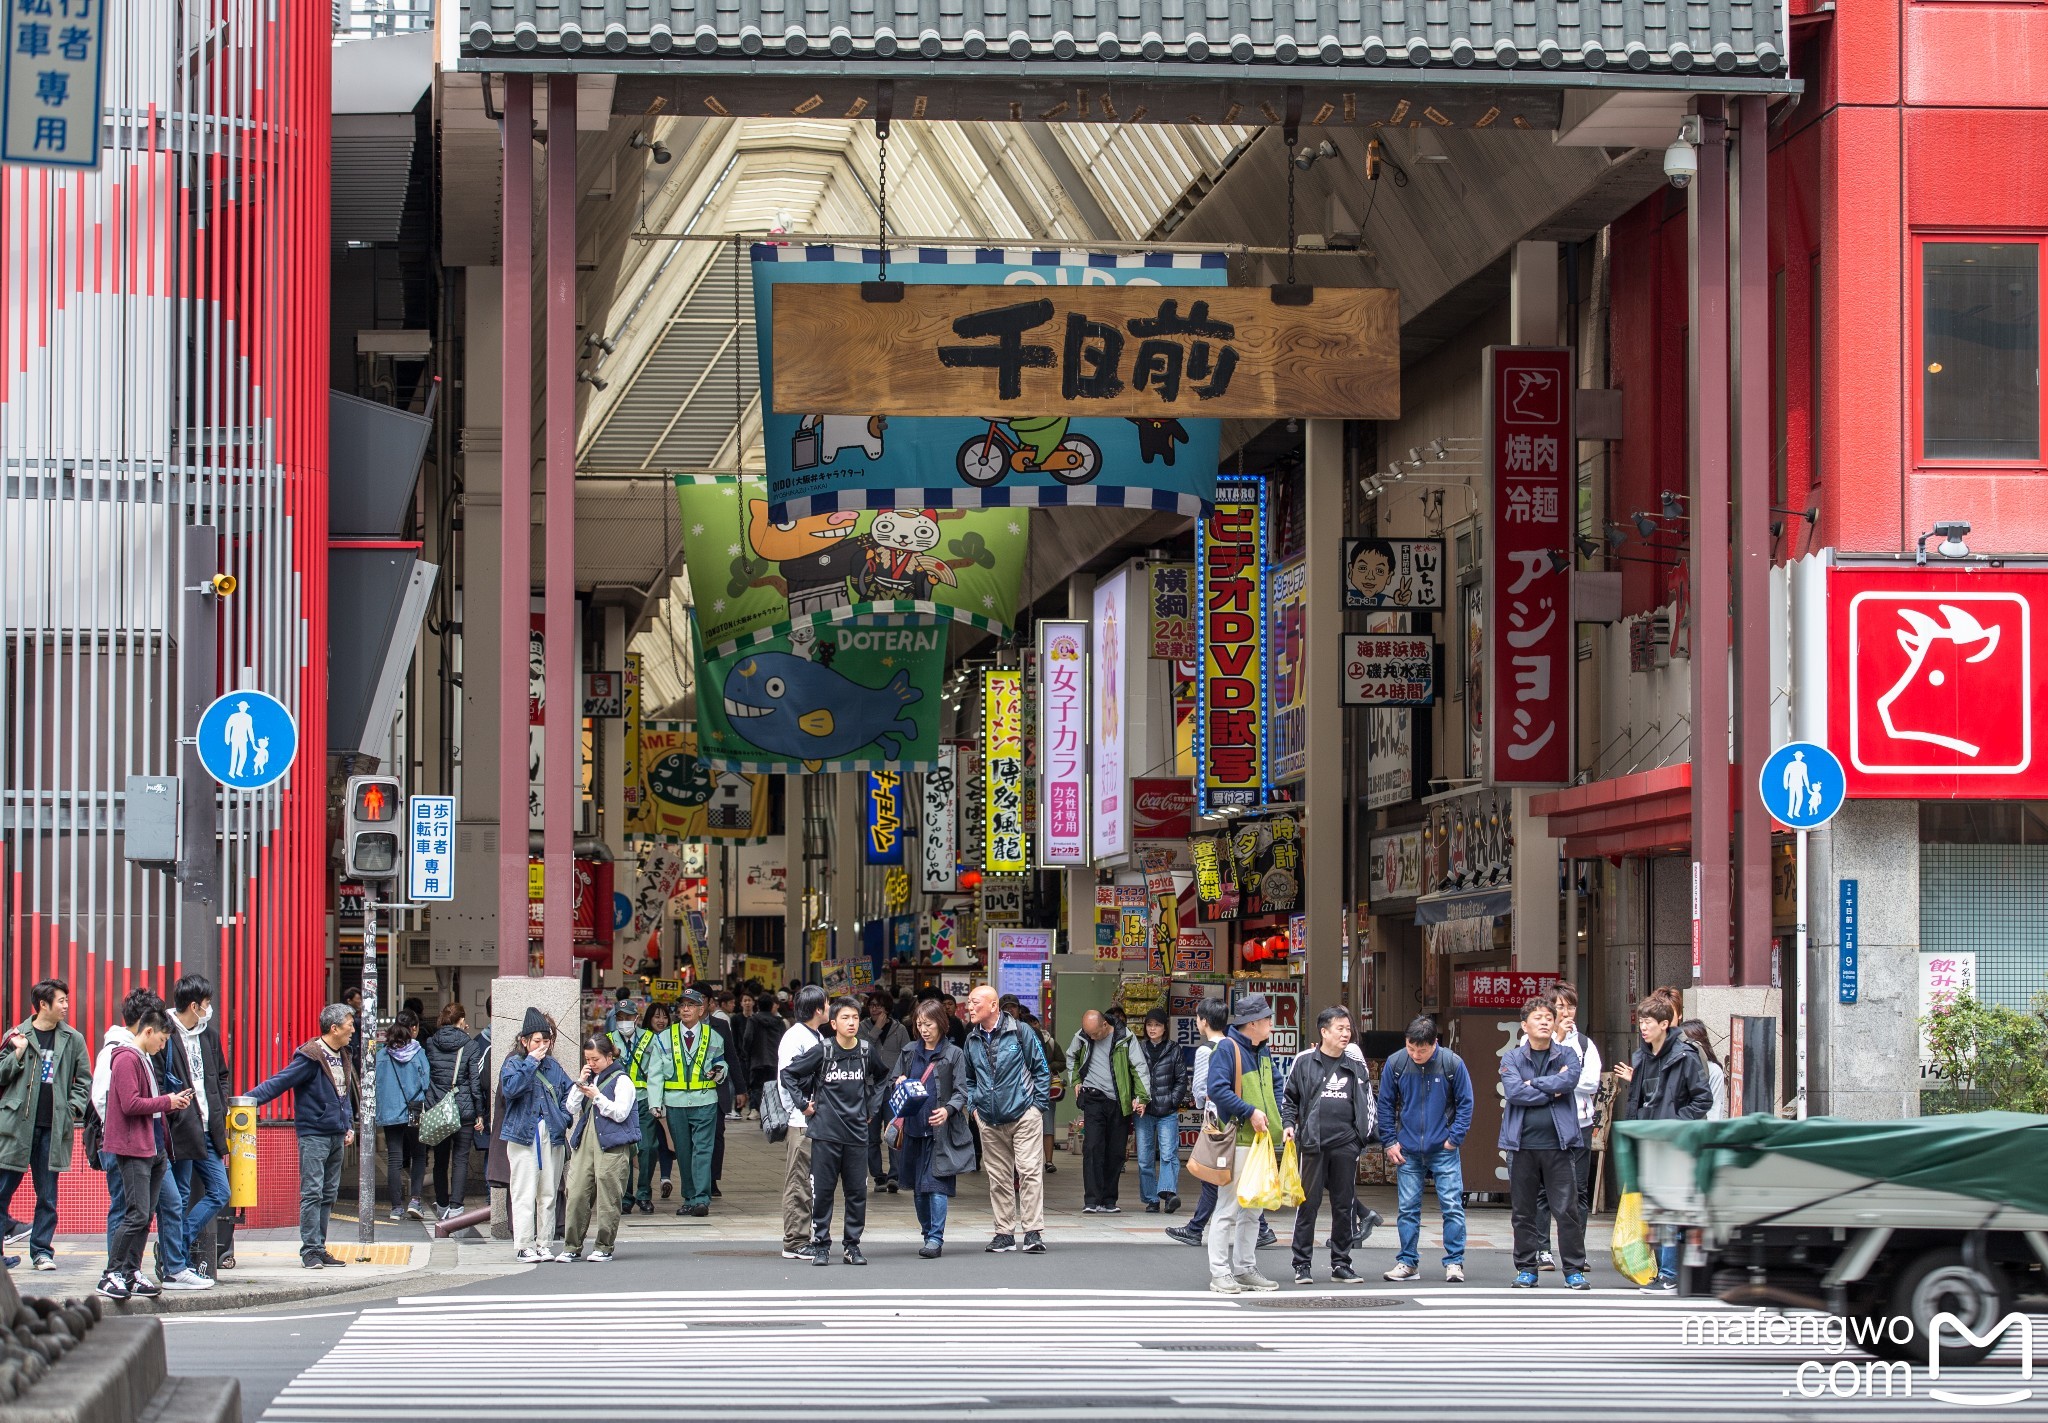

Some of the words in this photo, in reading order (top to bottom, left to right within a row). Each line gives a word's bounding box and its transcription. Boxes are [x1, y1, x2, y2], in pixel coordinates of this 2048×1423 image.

[33, 70, 70, 152] 専用
[938, 297, 1240, 402] 千日前
[1505, 433, 1559, 472] 焼肉
[1505, 485, 1559, 524] 冷麺
[1154, 568, 1188, 619] 横綱
[1414, 553, 1438, 606] 山ちゃん
[837, 629, 939, 652] DOTERAI
[1208, 508, 1258, 783] ビデオDVD試写
[1357, 641, 1426, 658] 海鮮浜焼
[1507, 548, 1556, 761] アジヨシ
[1366, 663, 1432, 679] 磯丸水産
[584, 698, 619, 714] がんこ
[1361, 684, 1423, 700] 24時間
[991, 679, 1006, 750] ラーメン
[1051, 664, 1079, 778] 女子カラ
[990, 757, 1022, 860] 博多風龍
[1053, 786, 1064, 833] カラオケ
[1066, 786, 1077, 833] 女性専用
[1211, 790, 1255, 806] 受付2F
[416, 803, 431, 854] 自転車
[433, 803, 448, 854] 歩行者
[1271, 816, 1297, 868] 時計
[424, 859, 439, 893] 専用
[1192, 841, 1222, 900] 査定無料
[1238, 831, 1263, 892] ダイヤ
[529, 903, 544, 922] 理
[1122, 914, 1147, 935] 15%
[1247, 897, 1296, 914] WaiWai
[1845, 899, 1853, 949] 千日前一丁目
[1098, 946, 1120, 959] 398
[1122, 934, 1147, 946] OFF
[1152, 960, 1211, 970] 大藥妝店
[1845, 957, 1853, 967] 9
[655, 981, 678, 990] BT21
[1250, 982, 1298, 993] KIN-HANA
[1178, 1031, 1201, 1045] 2F
[1321, 1090, 1348, 1099] adidas
